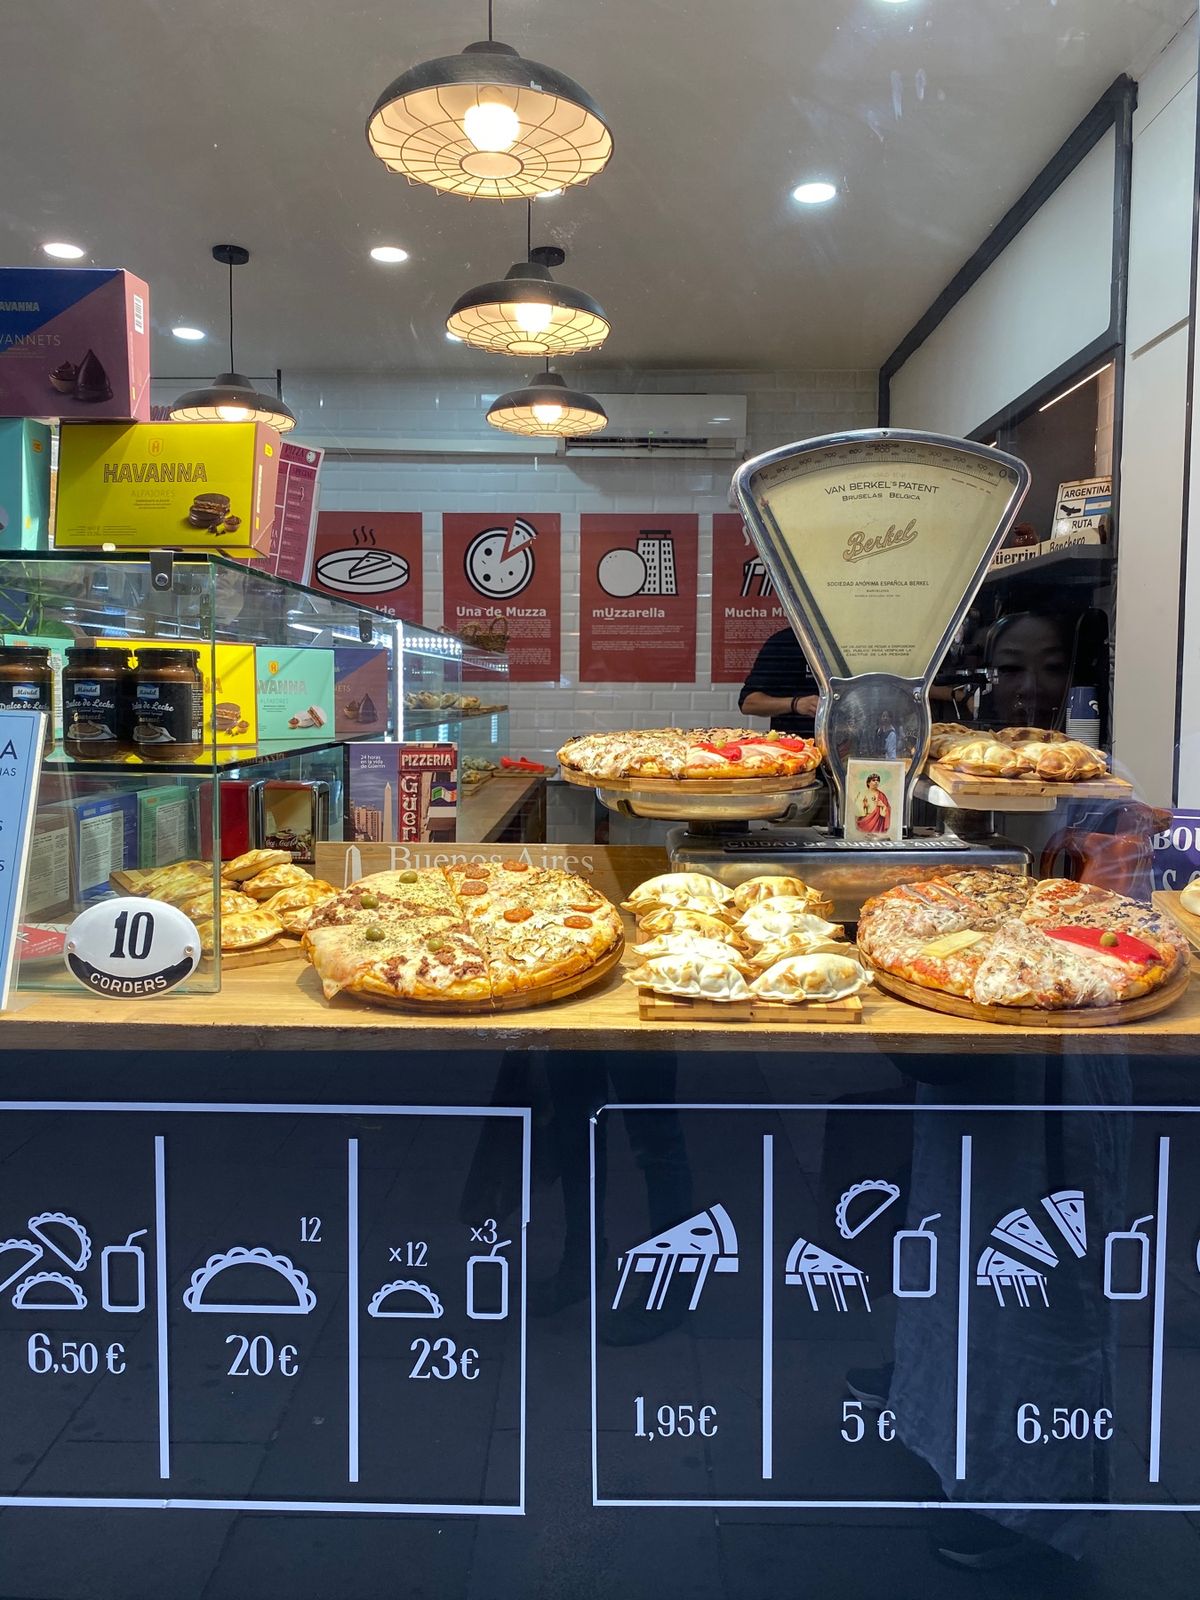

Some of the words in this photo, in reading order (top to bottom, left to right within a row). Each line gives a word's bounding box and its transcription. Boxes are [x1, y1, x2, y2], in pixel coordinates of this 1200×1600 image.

[103, 462, 208, 483] HAVANNA
[825, 484, 846, 495] VAN
[898, 481, 940, 494] PATENT
[1064, 485, 1111, 499] ARGENTINA
[842, 492, 883, 502] BRUSELAS
[889, 492, 921, 501] BELGICA
[1071, 519, 1093, 529] RUTA
[842, 518, 918, 563] Berkel
[992, 549, 1036, 565] üerrin
[880, 579, 908, 587] ESPAÑOLA
[456, 606, 482, 617] Una
[485, 606, 502, 617] de
[506, 606, 547, 617] Muzza
[592, 607, 665, 619] mUzzarella
[724, 607, 767, 617] Mucha
[23, 700, 32, 709] de
[92, 698, 115, 709] Leche
[151, 701, 175, 712] Leche
[401, 753, 452, 767] PIZZERIA
[401, 775, 418, 841] Güer
[727, 840, 797, 848] CIUDAD
[834, 840, 906, 848] BUENOS
[109, 910, 155, 960] 10
[299, 1216, 322, 1242] 12
[470, 1218, 498, 1244] x3
[633, 1395, 719, 1443] 1,95€
[840, 1401, 865, 1444] 5
[877, 1409, 897, 1443] €
